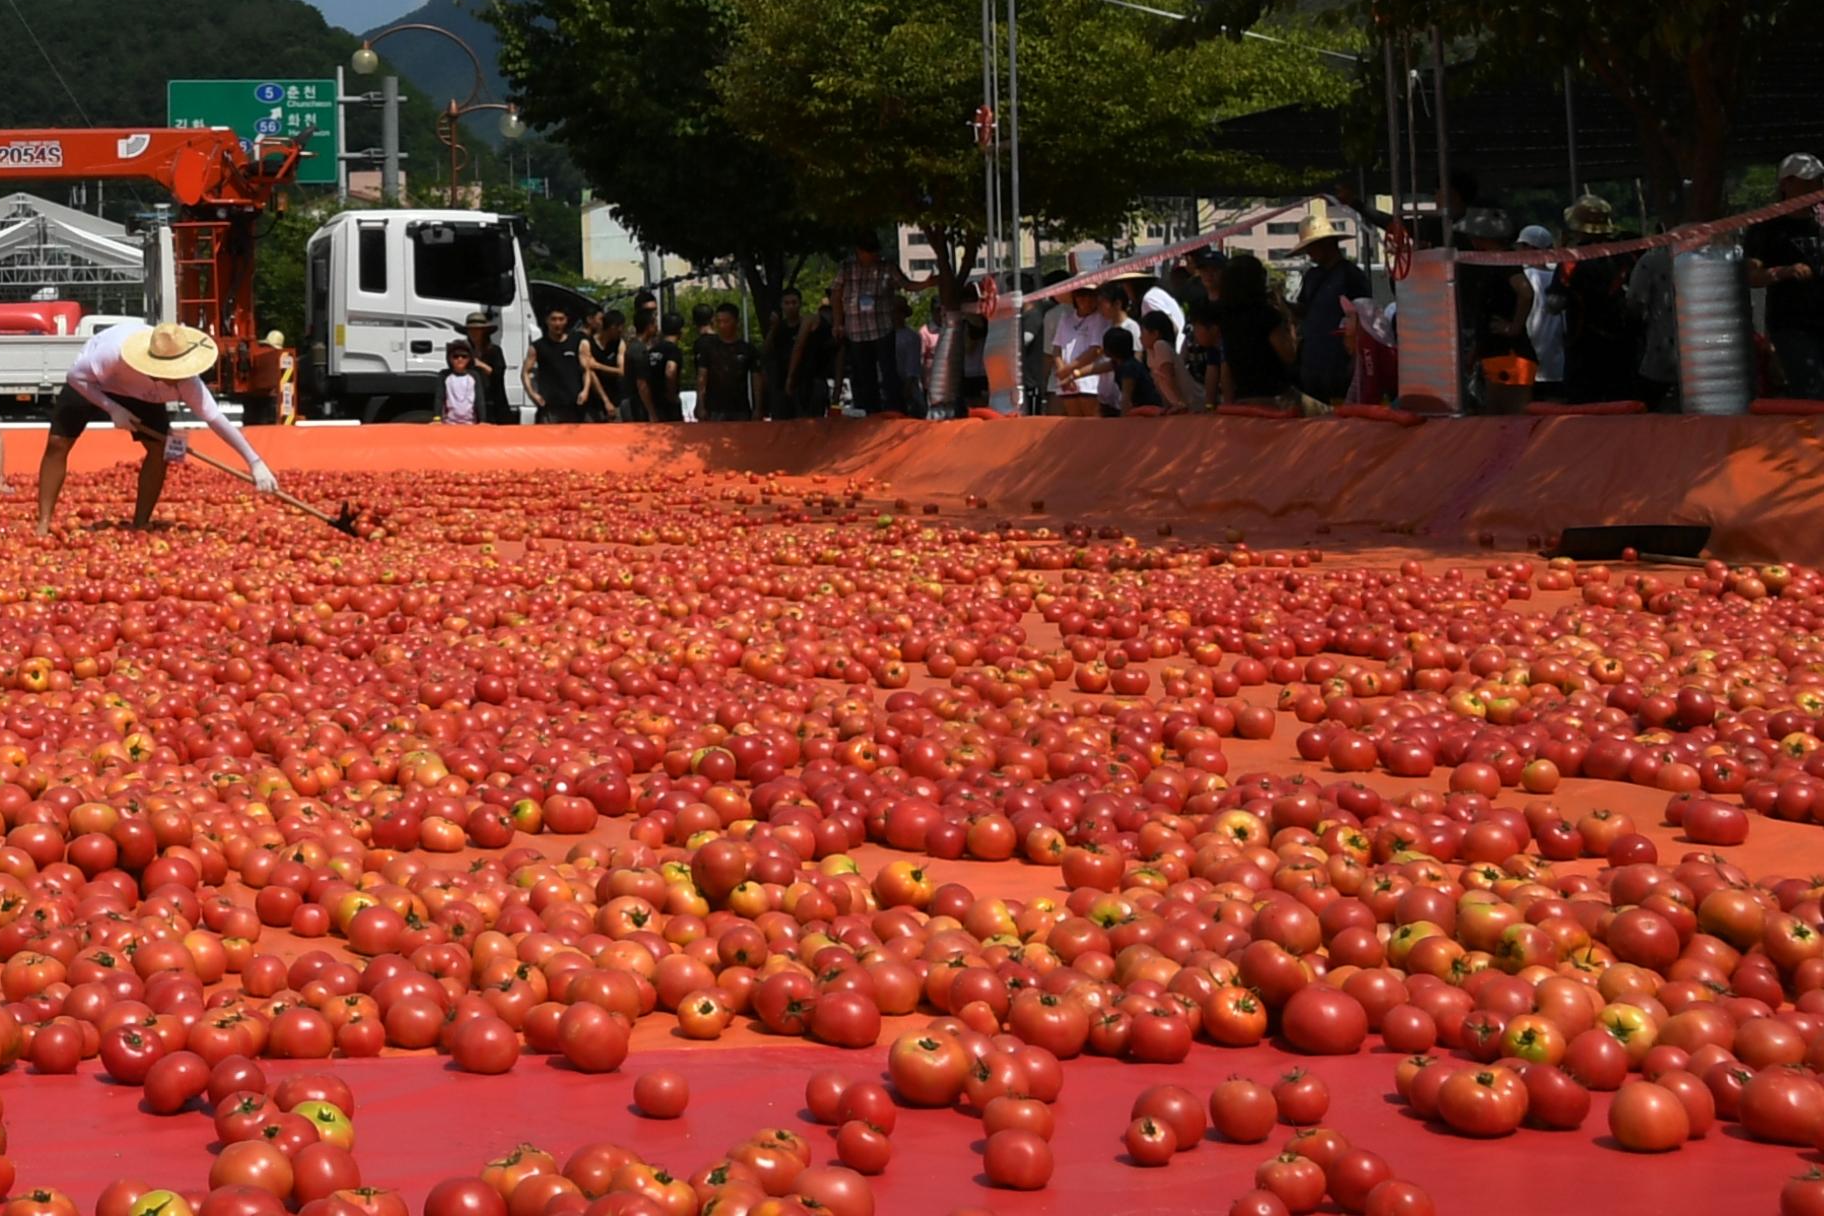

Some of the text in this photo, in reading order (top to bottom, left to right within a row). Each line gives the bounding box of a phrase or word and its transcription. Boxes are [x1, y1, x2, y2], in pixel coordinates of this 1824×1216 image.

[265, 87, 274, 99] 5
[287, 86, 316, 99] 춘천
[260, 121, 275, 133] 56
